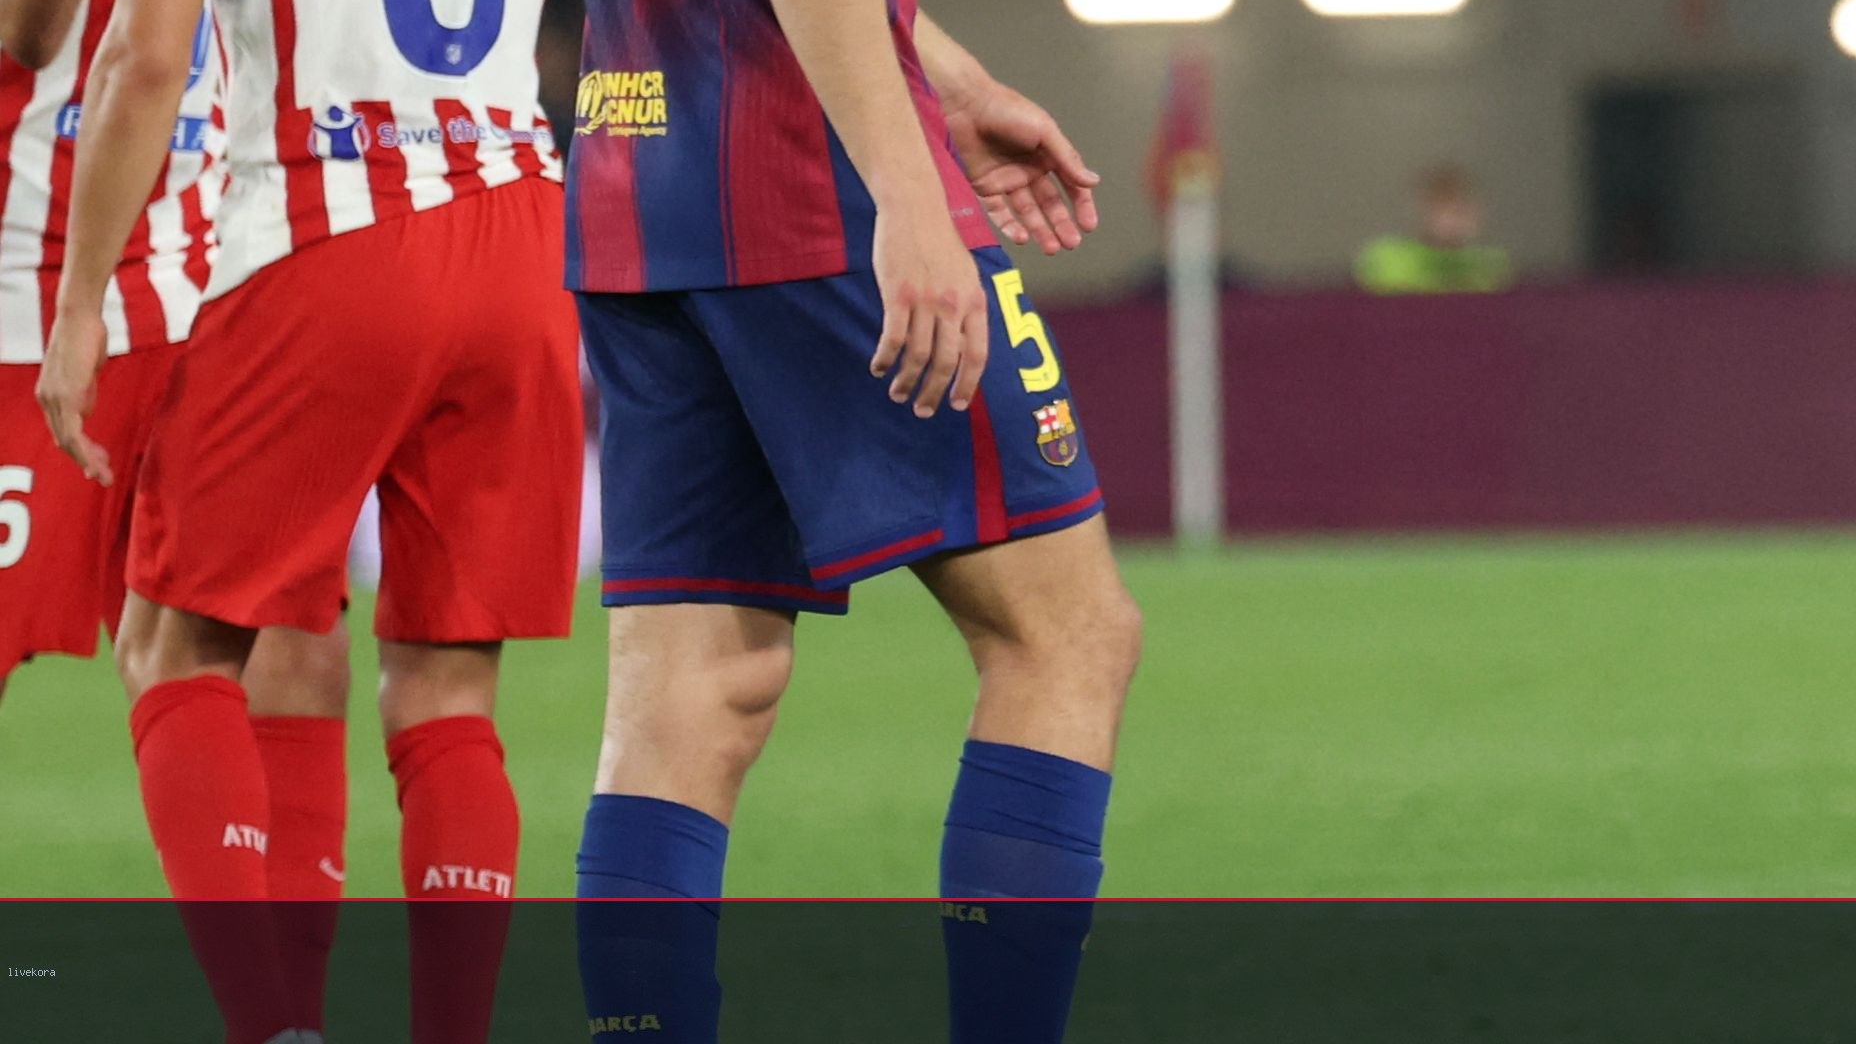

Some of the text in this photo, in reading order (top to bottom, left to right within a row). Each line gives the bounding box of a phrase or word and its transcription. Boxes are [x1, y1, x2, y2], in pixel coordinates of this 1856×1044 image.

[602, 71, 664, 97] NHCR
[606, 98, 667, 124] CNUR
[377, 123, 441, 148] Save
[448, 115, 486, 143] the
[992, 269, 1060, 393] 5
